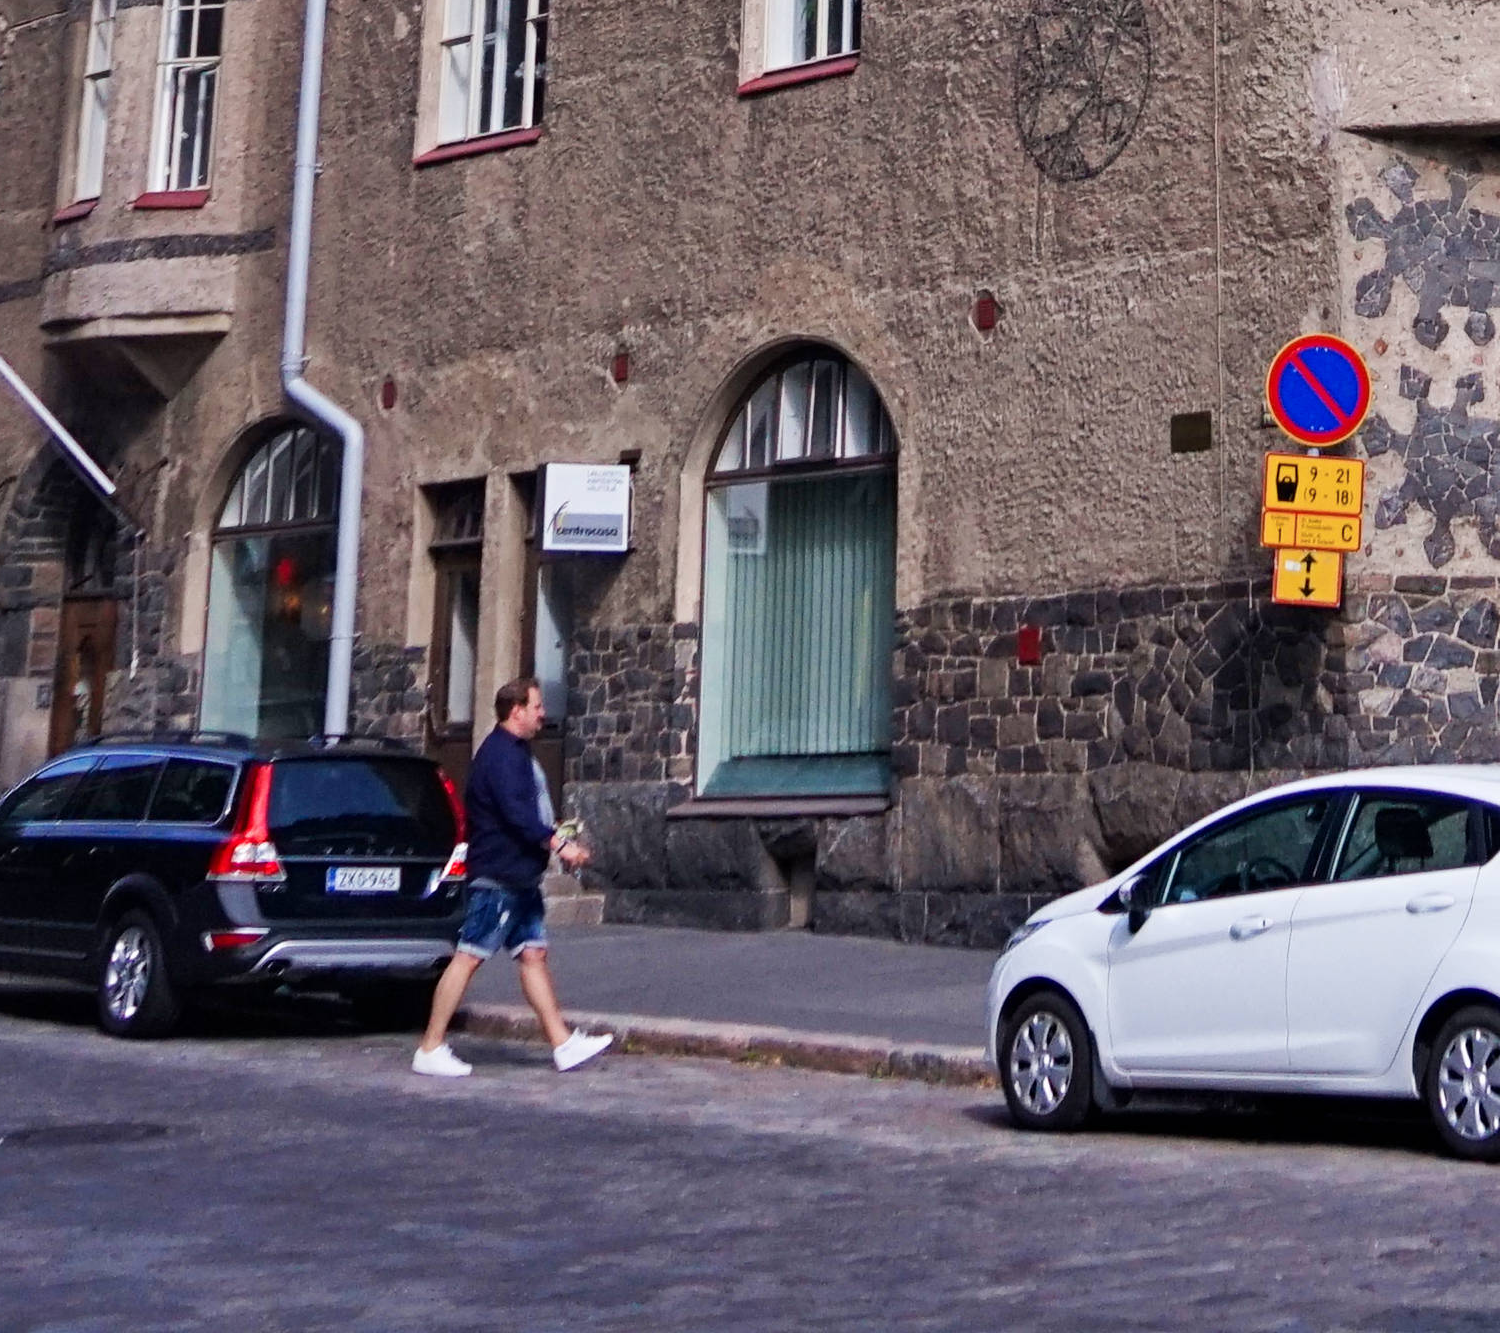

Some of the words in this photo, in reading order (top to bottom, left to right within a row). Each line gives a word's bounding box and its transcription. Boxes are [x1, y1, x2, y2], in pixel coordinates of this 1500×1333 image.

[1310, 466, 1318, 482] 9
[1336, 468, 1350, 484] 21
[1303, 487, 1317, 503] (9
[1336, 489, 1354, 506] 18)
[1278, 528, 1282, 542] 1
[1341, 524, 1353, 542] C
